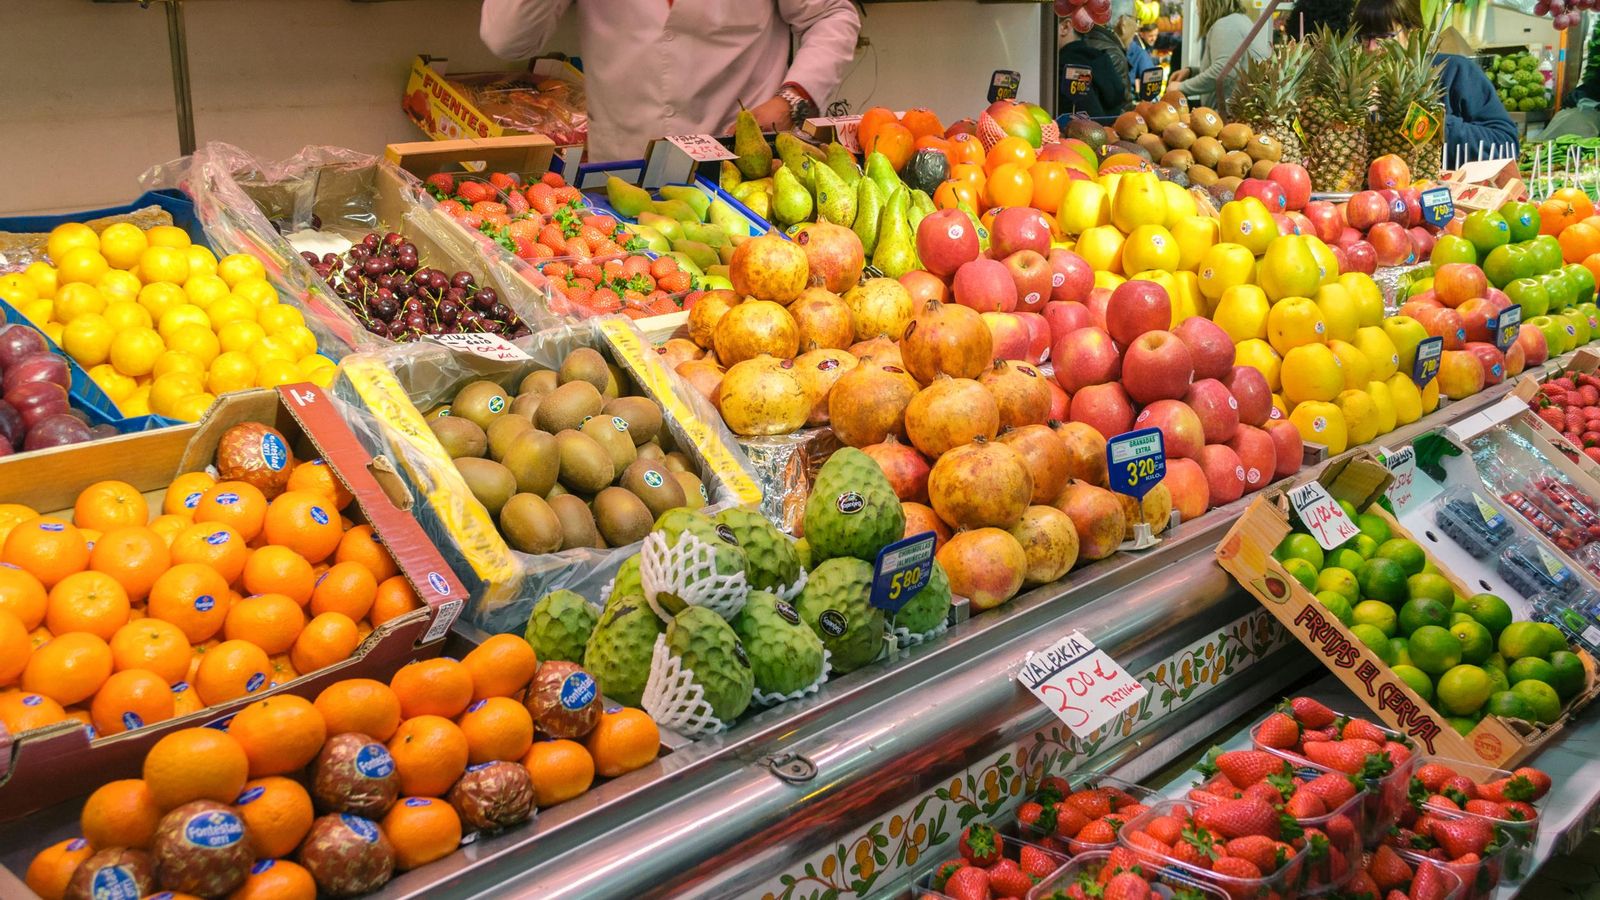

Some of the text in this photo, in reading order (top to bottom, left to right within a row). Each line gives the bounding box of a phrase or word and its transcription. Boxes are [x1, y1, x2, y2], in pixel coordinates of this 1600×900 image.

[423, 73, 489, 139] FUENTES
[1129, 435, 1156, 447] GRANADAS
[1135, 446, 1151, 454] EXTRA
[1294, 604, 1441, 755] FRUTAS EL CERVAL
[563, 675, 594, 707] Fontestad
[188, 822, 242, 840] Fontestad
[209, 836, 230, 846] orri
